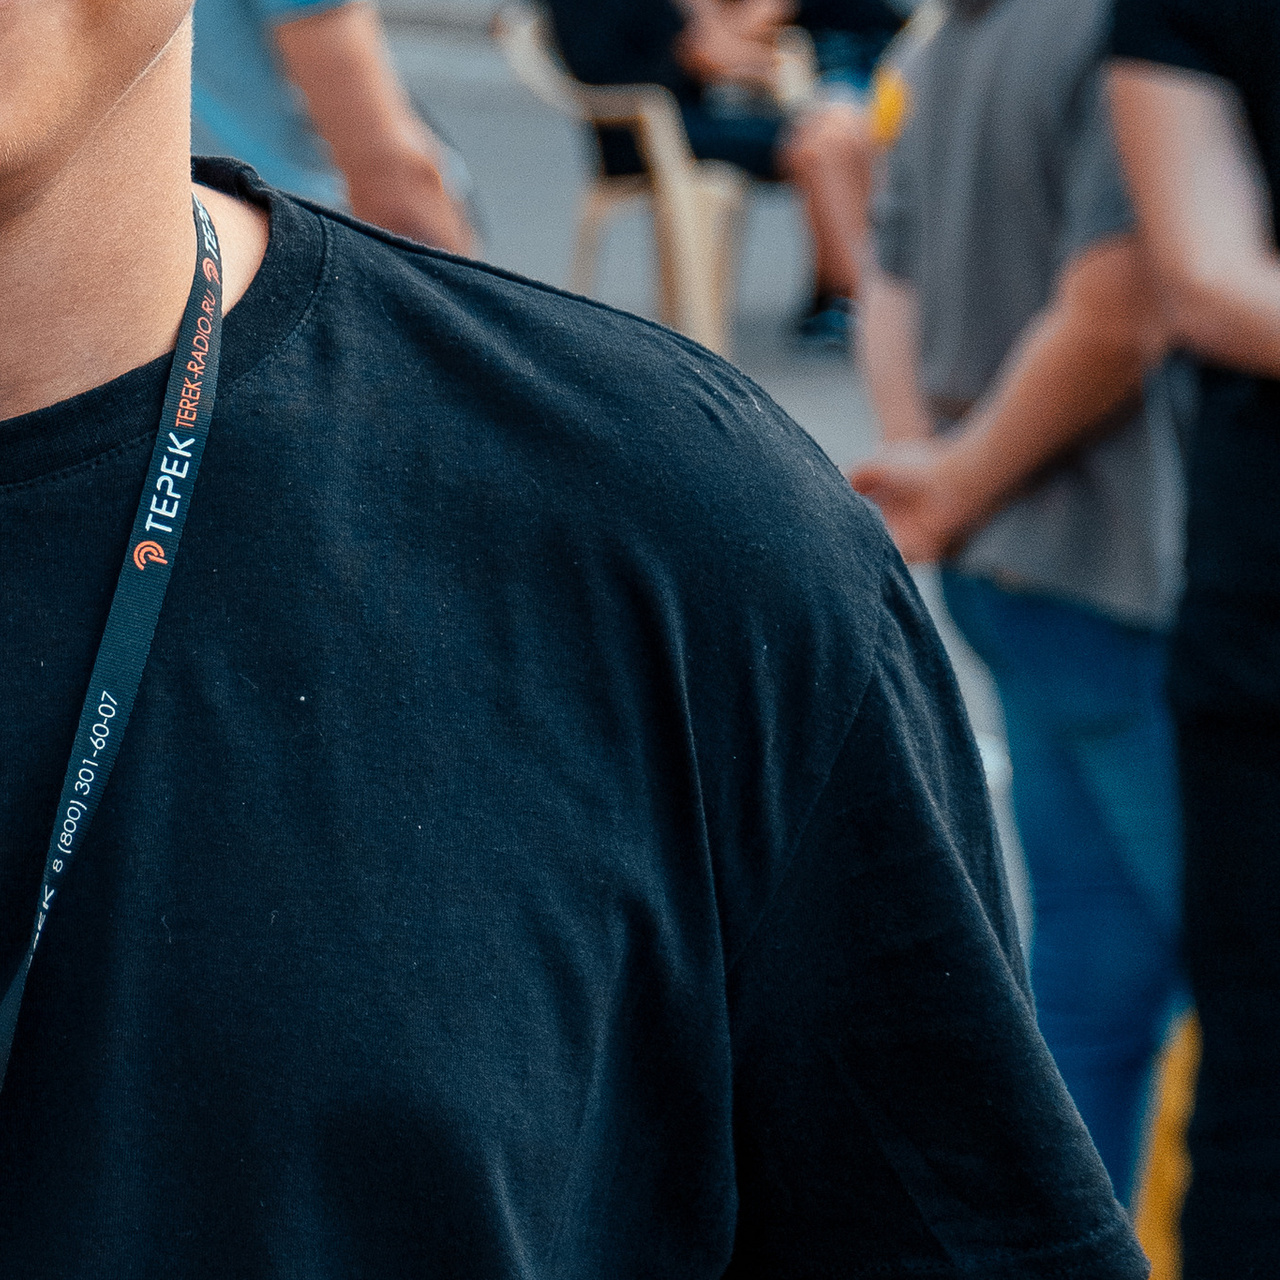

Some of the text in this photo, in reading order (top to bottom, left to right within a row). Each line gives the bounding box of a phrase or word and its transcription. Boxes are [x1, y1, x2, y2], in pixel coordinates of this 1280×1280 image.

[144, 289, 217, 533] ТЕРЕК TEREK-RADIO.RU
[52, 690, 118, 873] 8 (800) 301-60-07
